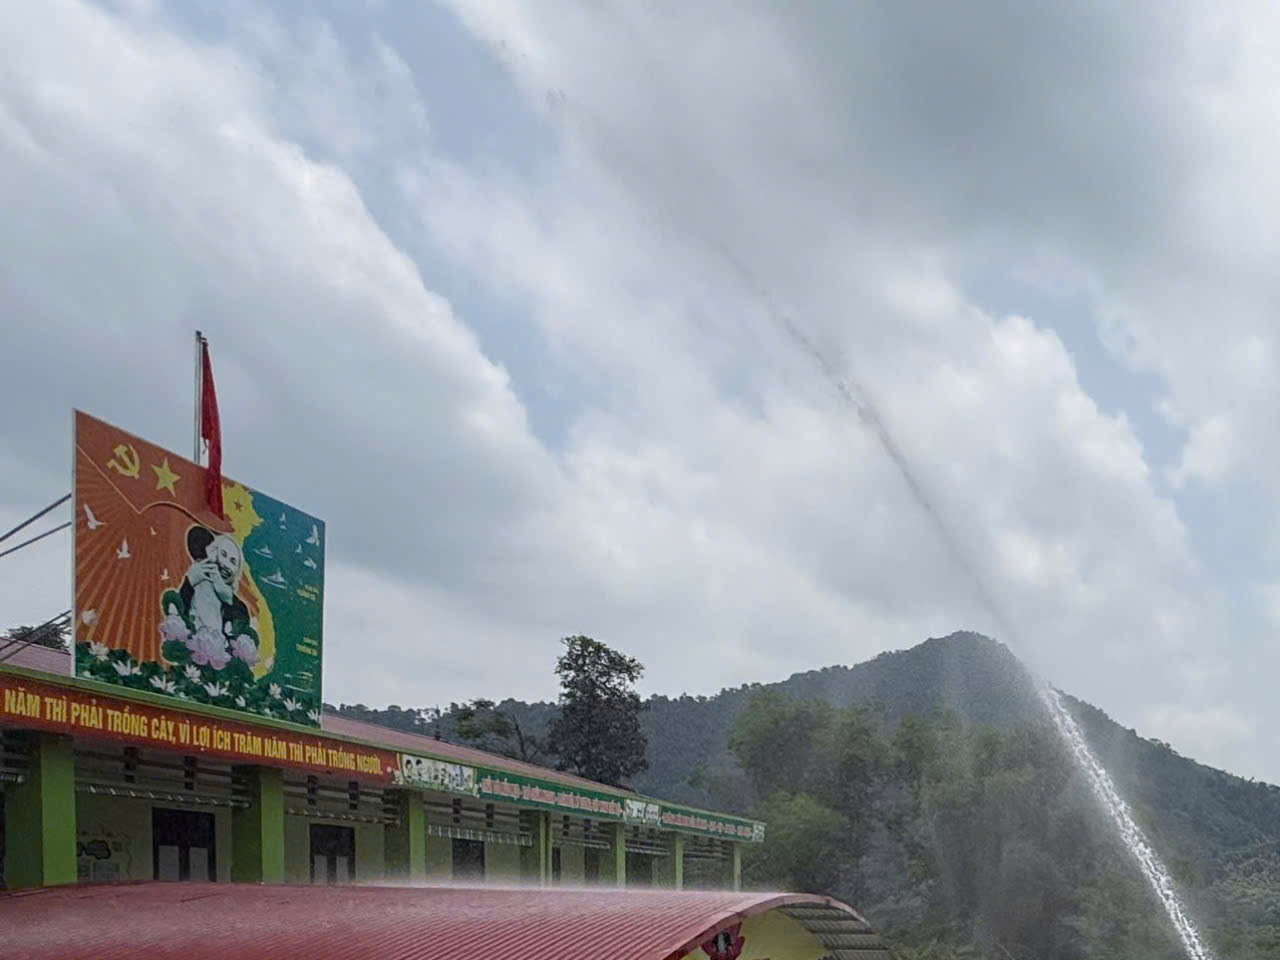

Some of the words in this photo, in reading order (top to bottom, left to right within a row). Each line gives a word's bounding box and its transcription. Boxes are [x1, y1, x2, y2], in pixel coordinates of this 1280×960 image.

[4, 687, 40, 718] NĂM
[45, 695, 67, 723] THÌ
[71, 699, 103, 729] PHẢI
[151, 715, 176, 744] CÂY,
[178, 720, 190, 744] VÌ
[193, 724, 210, 751] LỢI
[213, 725, 231, 751] ÍCH
[233, 732, 261, 756] TRĂM
[264, 737, 287, 760] NĂM
[288, 741, 303, 763] THÌ
[305, 742, 326, 766] PHẢI
